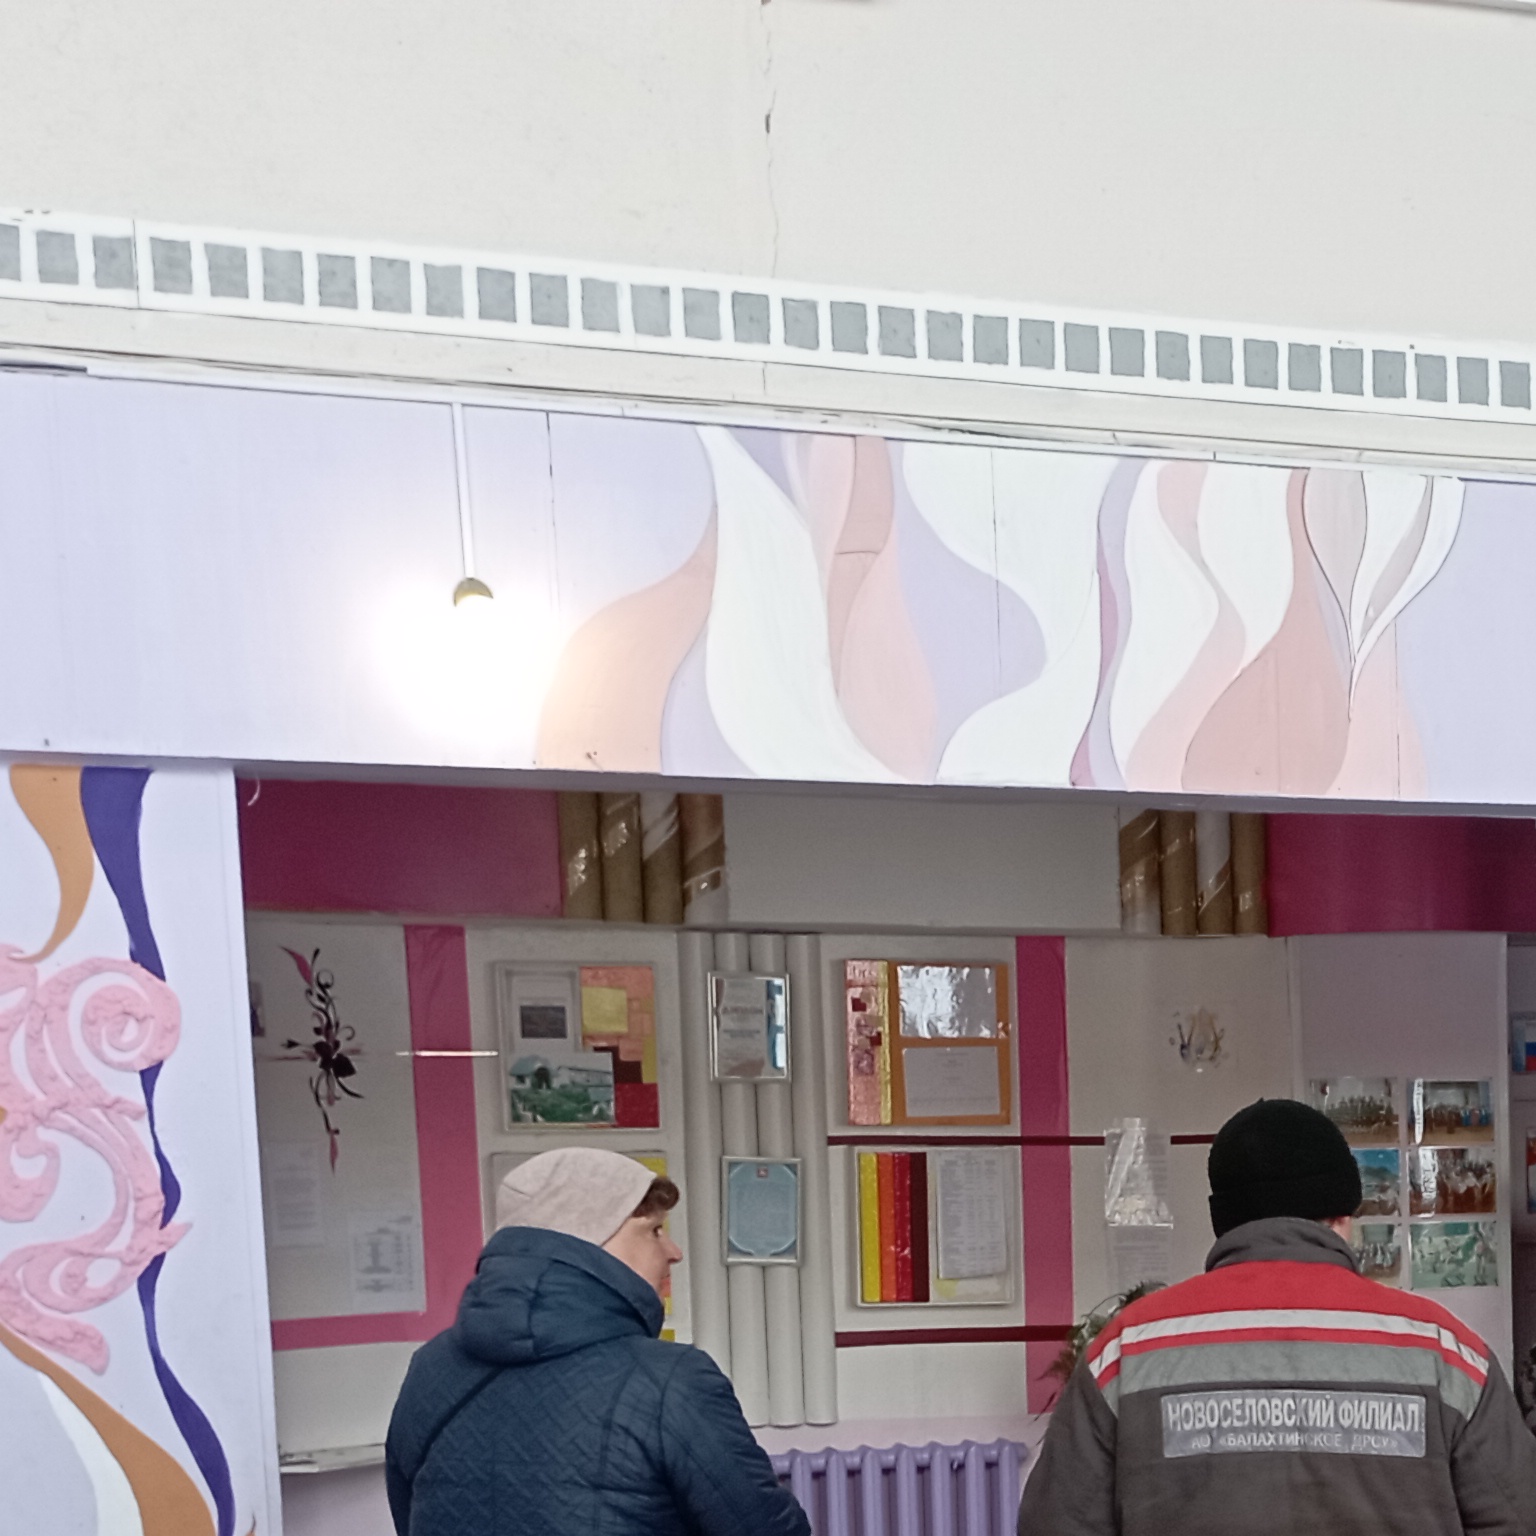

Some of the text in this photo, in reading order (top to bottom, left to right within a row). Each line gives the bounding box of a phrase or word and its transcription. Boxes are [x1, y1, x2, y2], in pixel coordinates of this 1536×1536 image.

[1168, 1395, 1420, 1432] НОВОСЕЛОВСКИЙ ФИЛИАЛ
[1191, 1434, 1211, 1449] АО
